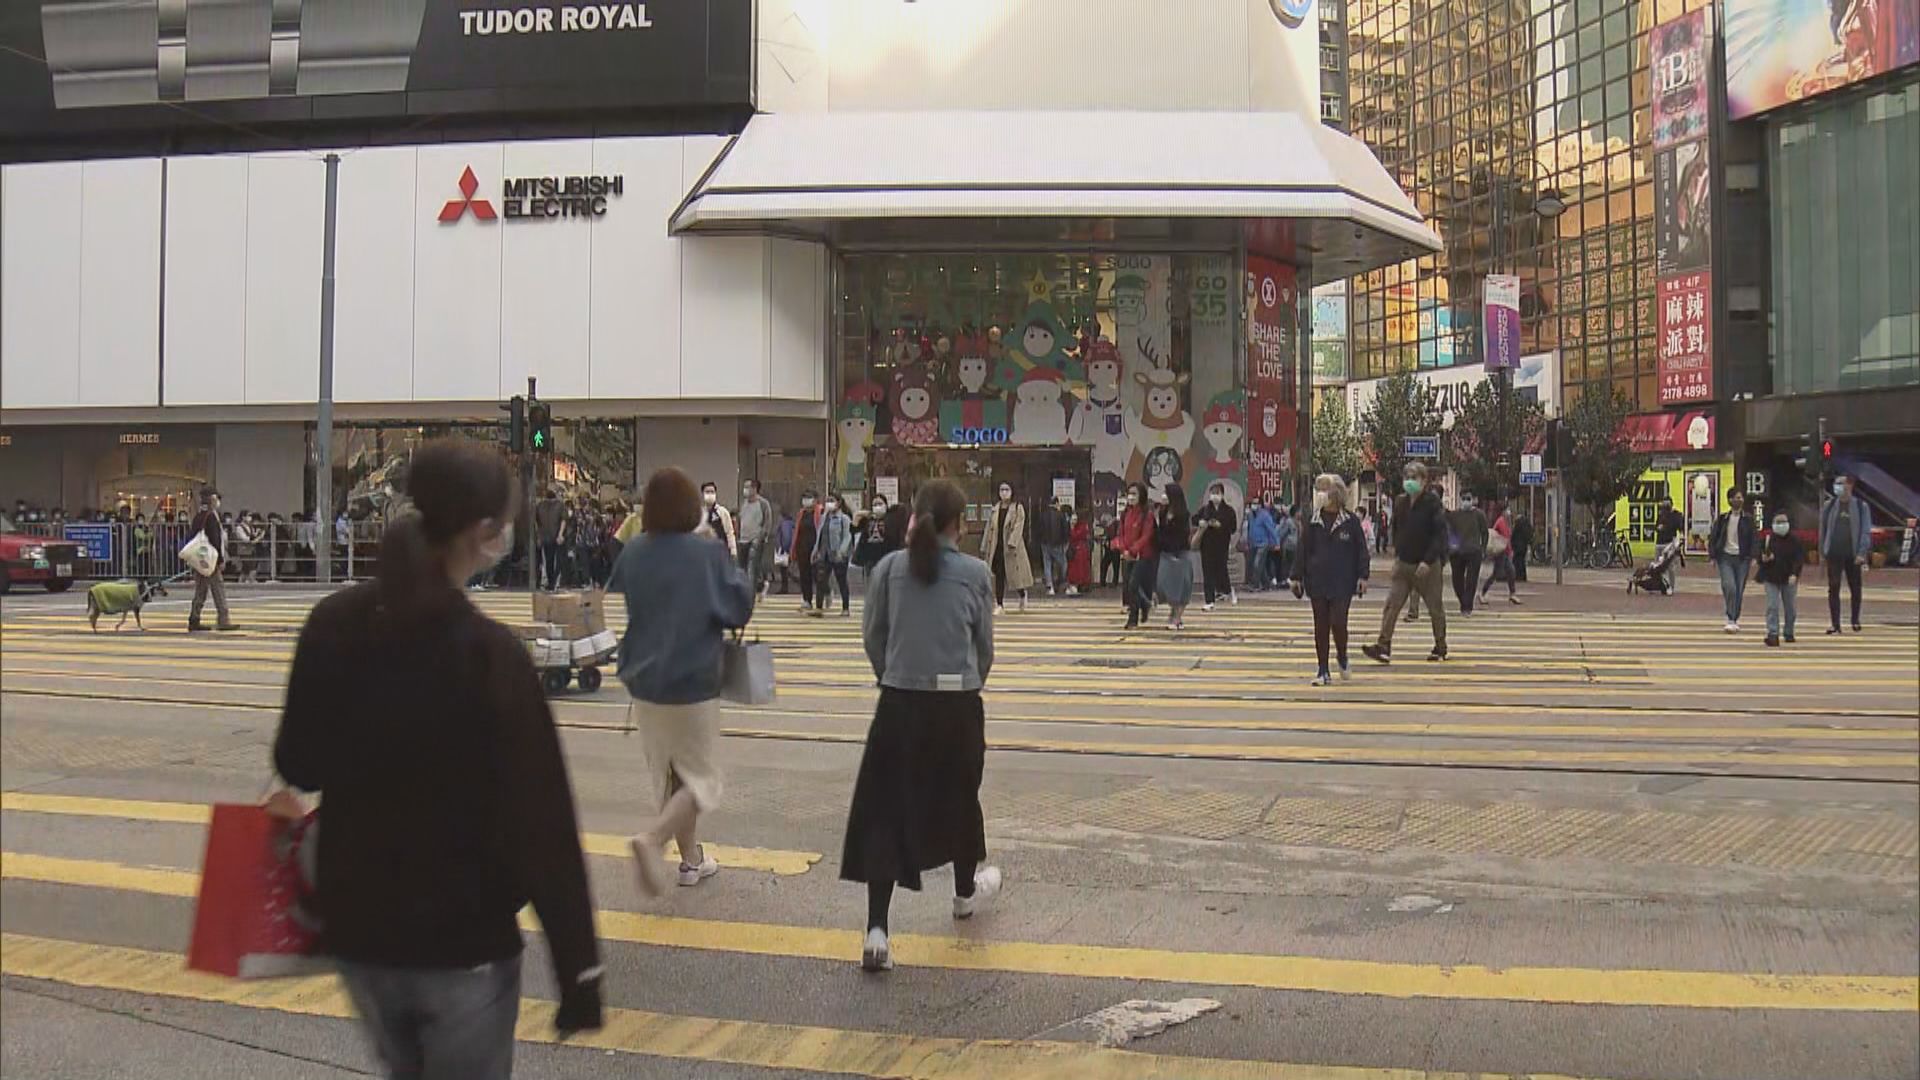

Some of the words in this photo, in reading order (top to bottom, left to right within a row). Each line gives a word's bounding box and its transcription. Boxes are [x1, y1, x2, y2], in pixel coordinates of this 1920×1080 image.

[460, 8, 554, 35] TUDOR
[561, 4, 652, 31] ROYAL
[504, 175, 623, 197] MITSUBISHI
[504, 197, 607, 218] ELECTRIC
[1193, 294, 1227, 317] 35
[1666, 292, 1704, 324] 麻辣
[1253, 321, 1286, 344] SHARE
[1667, 324, 1704, 356] 派對
[1259, 341, 1279, 360] THE
[1257, 360, 1283, 380] LOVE
[1662, 387, 1682, 400] 2178
[1684, 384, 1707, 398] 4898
[952, 426, 1008, 444] SOGO
[1253, 453, 1286, 470] SHARE
[1261, 471, 1281, 488] THE
